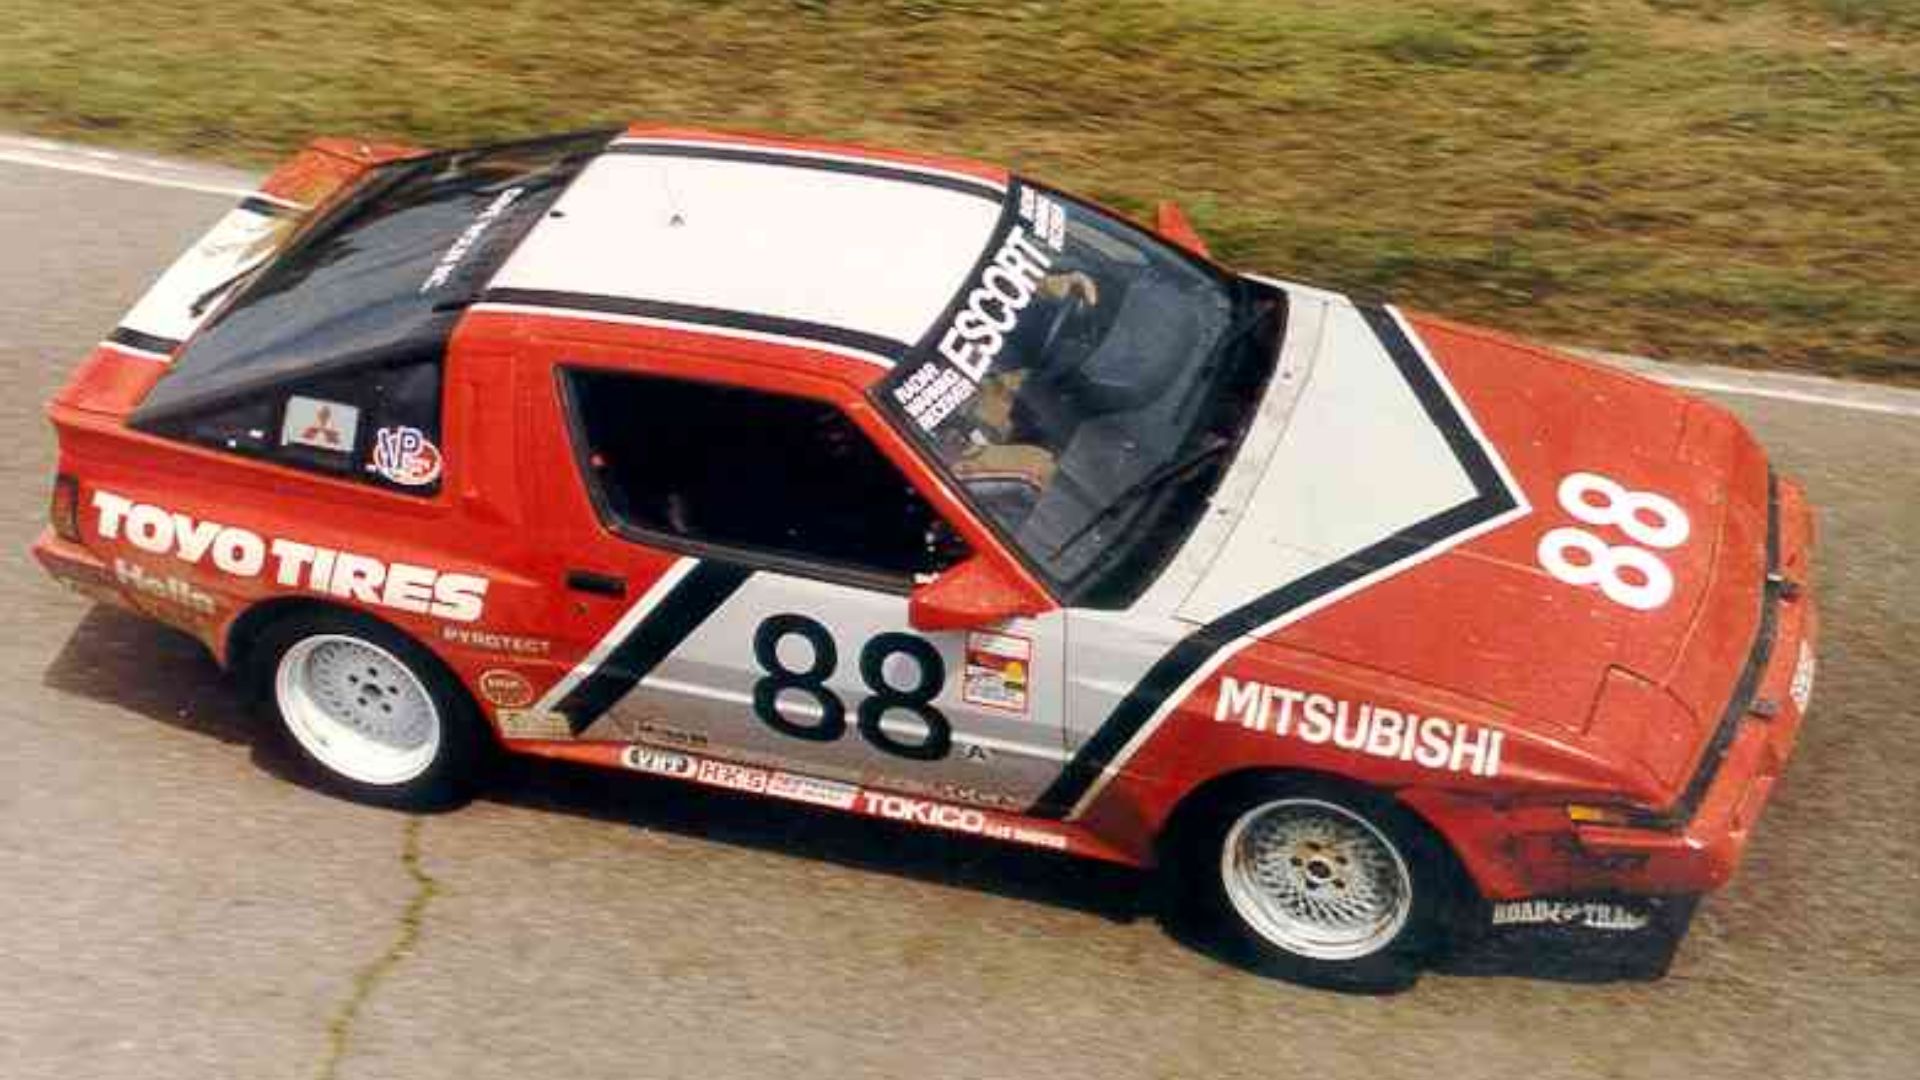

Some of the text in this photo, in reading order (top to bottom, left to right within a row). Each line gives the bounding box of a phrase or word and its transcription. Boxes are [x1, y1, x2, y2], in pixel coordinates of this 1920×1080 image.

[937, 224, 1052, 383] ESCORT
[92, 490, 489, 622] TOYO TIRES
[1537, 471, 1690, 610] 88
[443, 626, 551, 655] PYROTECT
[753, 613, 953, 761] 88
[1215, 676, 1504, 778] MITSUBISHI
[864, 792, 984, 833] TOKICO
